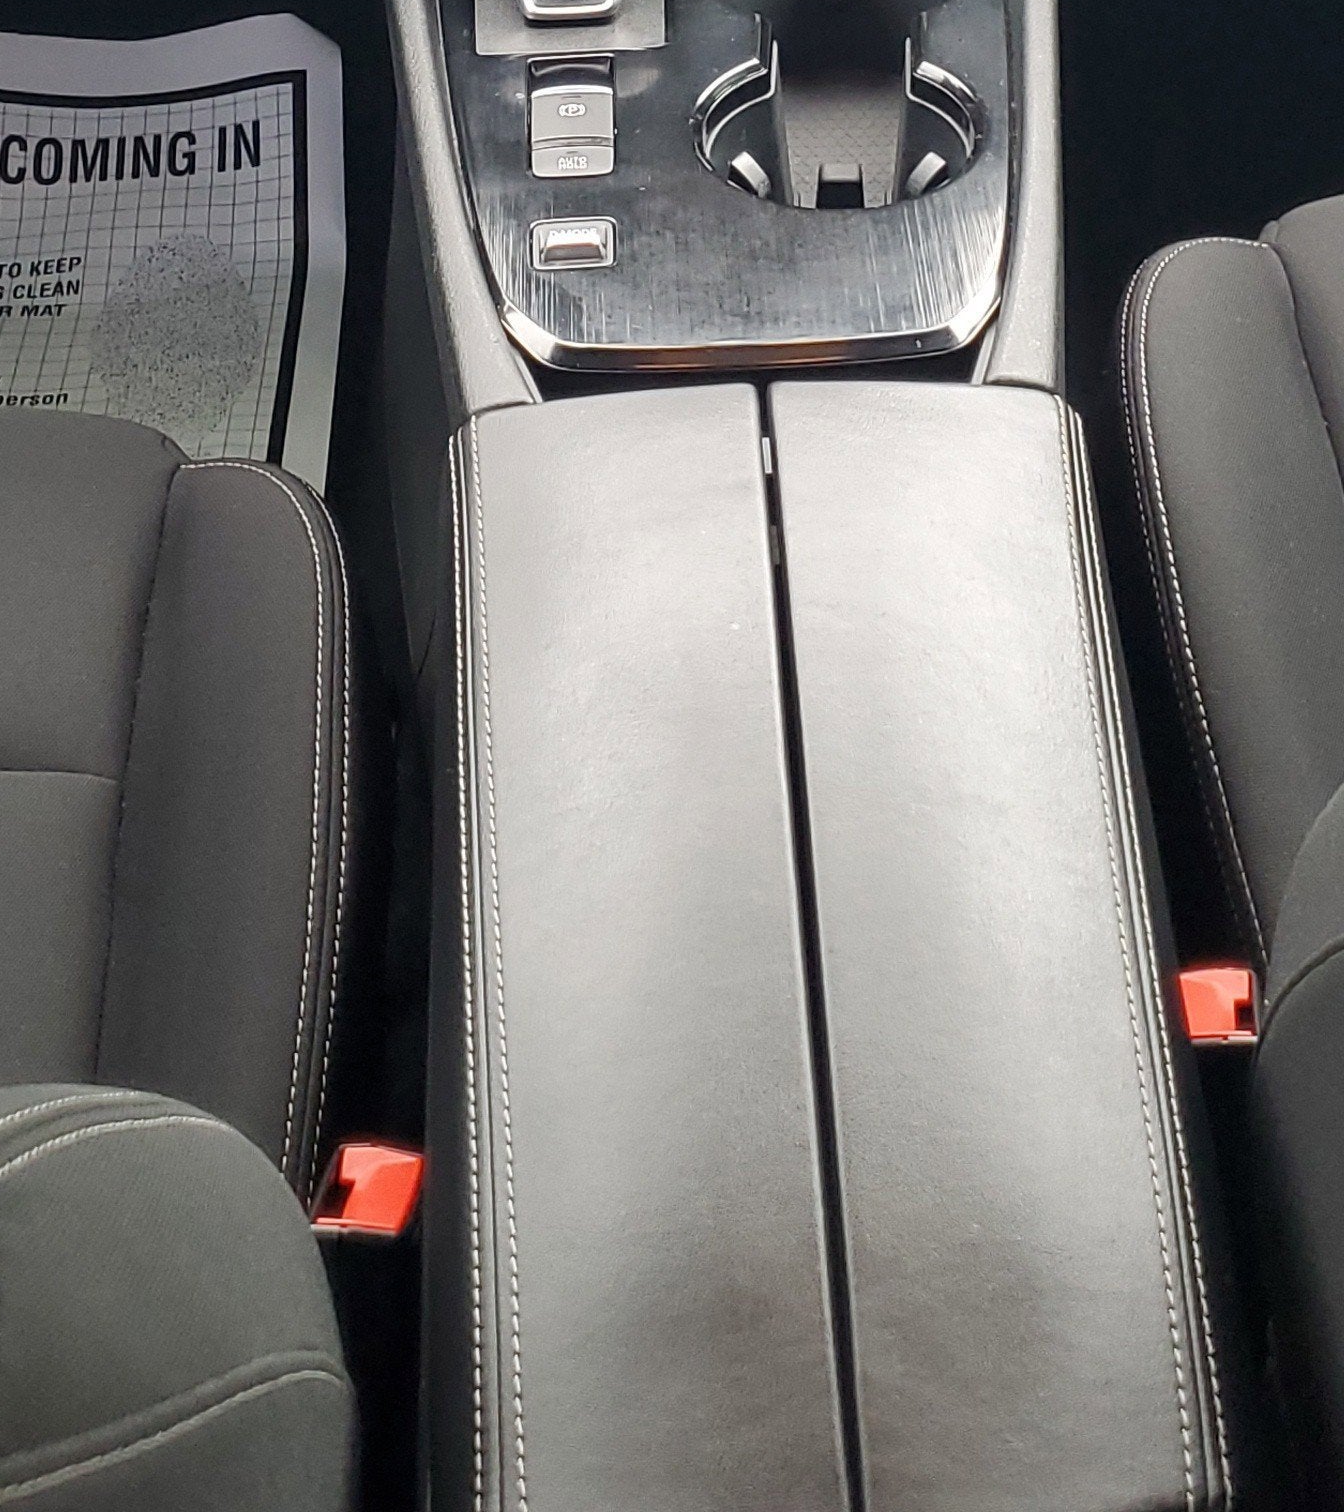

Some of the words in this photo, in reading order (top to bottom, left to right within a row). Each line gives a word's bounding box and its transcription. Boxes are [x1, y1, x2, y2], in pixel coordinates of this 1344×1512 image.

[0, 130, 196, 185] COMING
[217, 119, 261, 173] IN
[29, 256, 82, 277] KEEP
[12, 279, 81, 300] CLEAN
[20, 303, 68, 318] MAT
